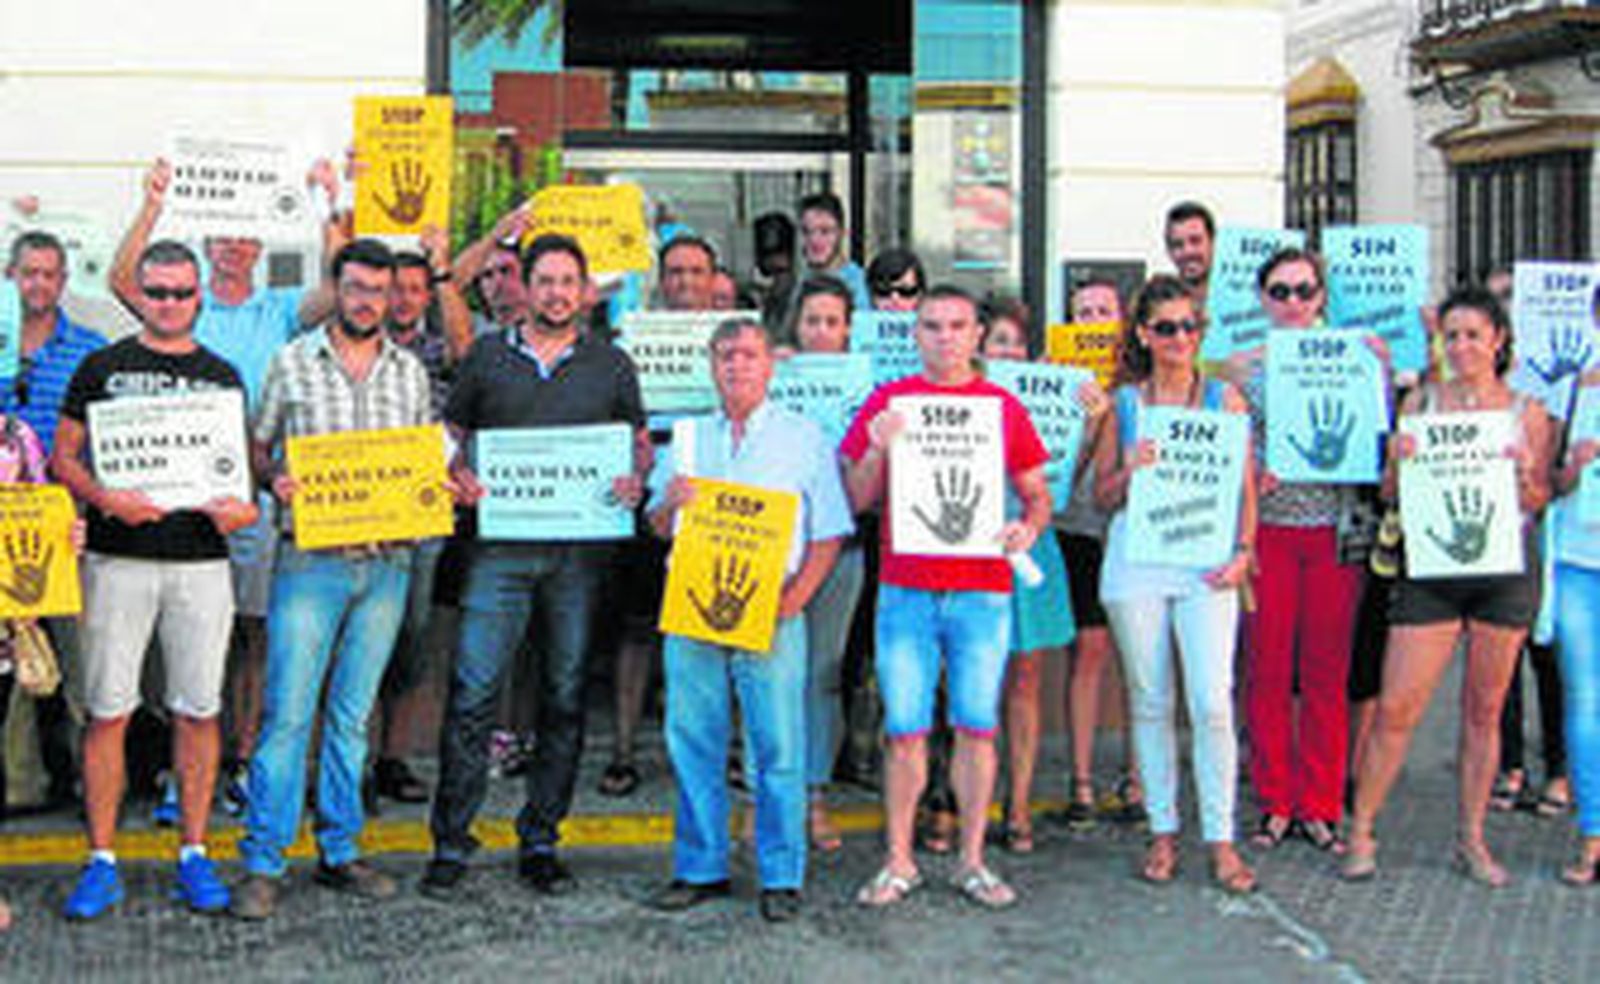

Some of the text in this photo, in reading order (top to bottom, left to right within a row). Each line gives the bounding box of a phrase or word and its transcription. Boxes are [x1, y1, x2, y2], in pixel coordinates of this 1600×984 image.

[1350, 236, 1397, 258] SIN
[1544, 272, 1590, 292] STOP
[1298, 338, 1347, 359] STOP
[1016, 375, 1064, 397] SIN
[921, 405, 972, 427] STOP
[1169, 419, 1219, 442] SIN
[1426, 424, 1479, 448] STOP
[715, 491, 766, 519] STOP
